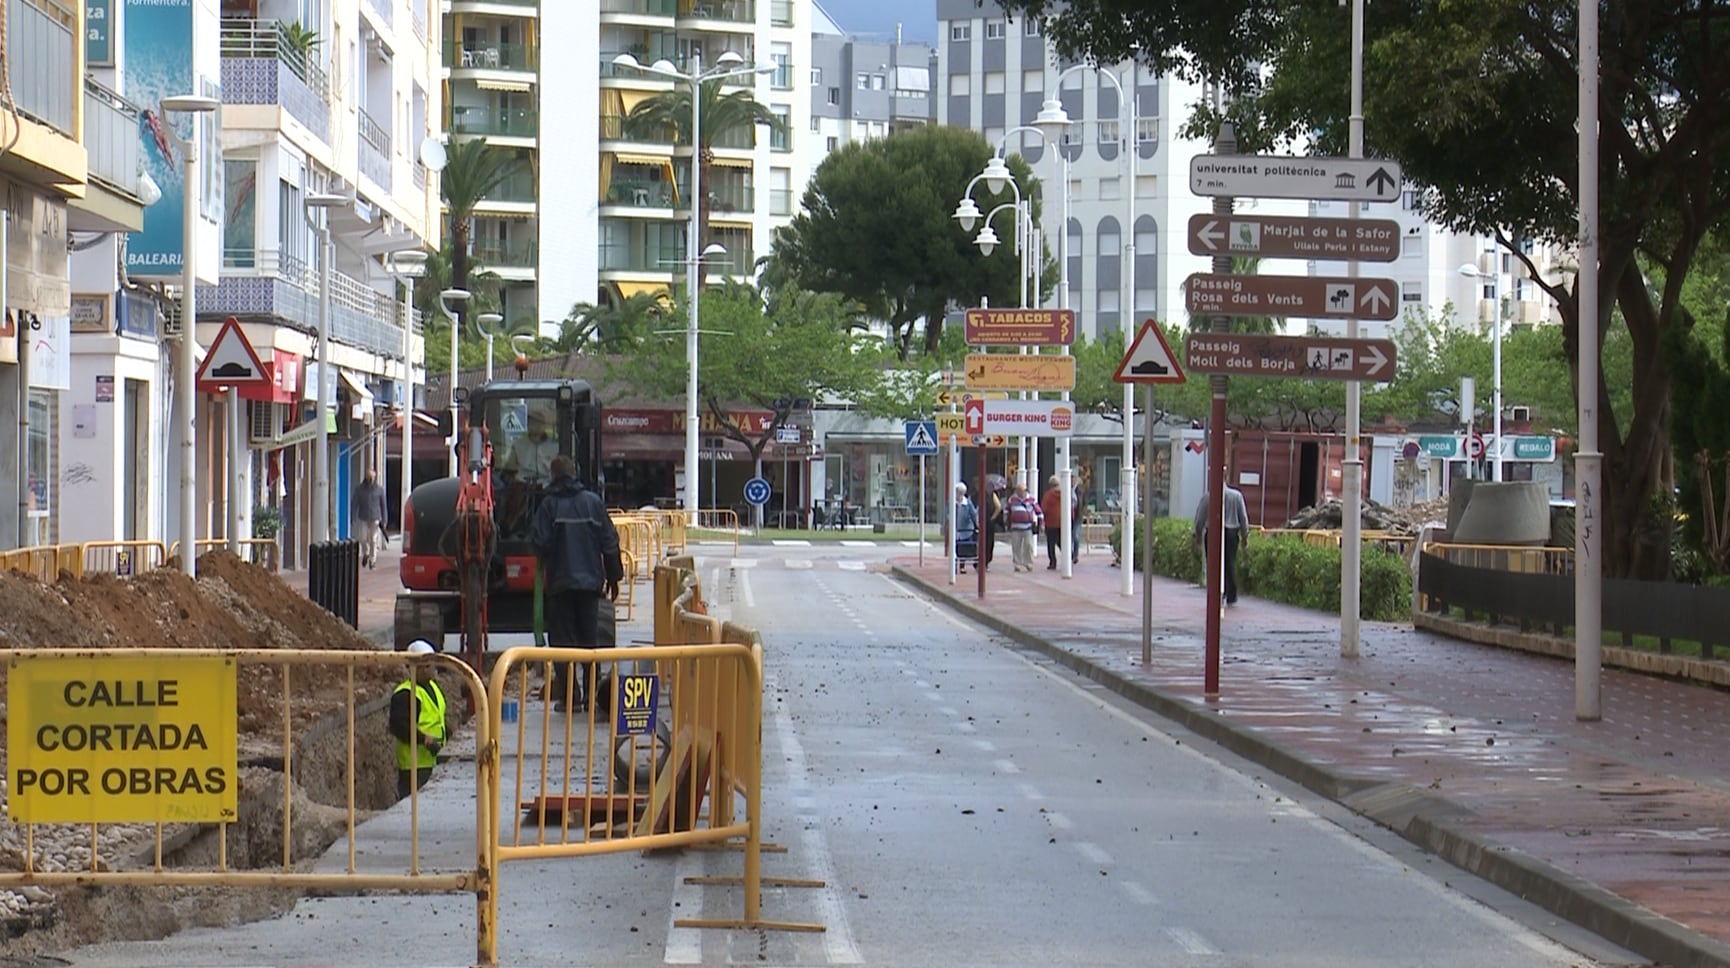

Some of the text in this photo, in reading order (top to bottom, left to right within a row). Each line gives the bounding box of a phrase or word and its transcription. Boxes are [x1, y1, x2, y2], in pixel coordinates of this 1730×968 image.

[87, 28, 105, 40] a.
[1197, 164, 1258, 174] universitat
[1207, 180, 1227, 188] min.
[1264, 225, 1391, 240] Marjal de la Safor
[128, 253, 184, 265] BALEARI
[1192, 279, 1242, 291] Passeig
[1192, 292, 1303, 306] Rosa dels Vents
[988, 313, 1052, 323] TABACOS
[1190, 341, 1240, 355] Passeig
[1190, 355, 1295, 371] Moll dels Borja
[987, 413, 1047, 423] BURGER KING
[1519, 444, 1550, 452] REGALO
[64, 680, 178, 707] CALLE
[624, 677, 653, 708] SPV
[36, 723, 208, 751] CORTADA
[17, 767, 226, 795] POR OBRAS
